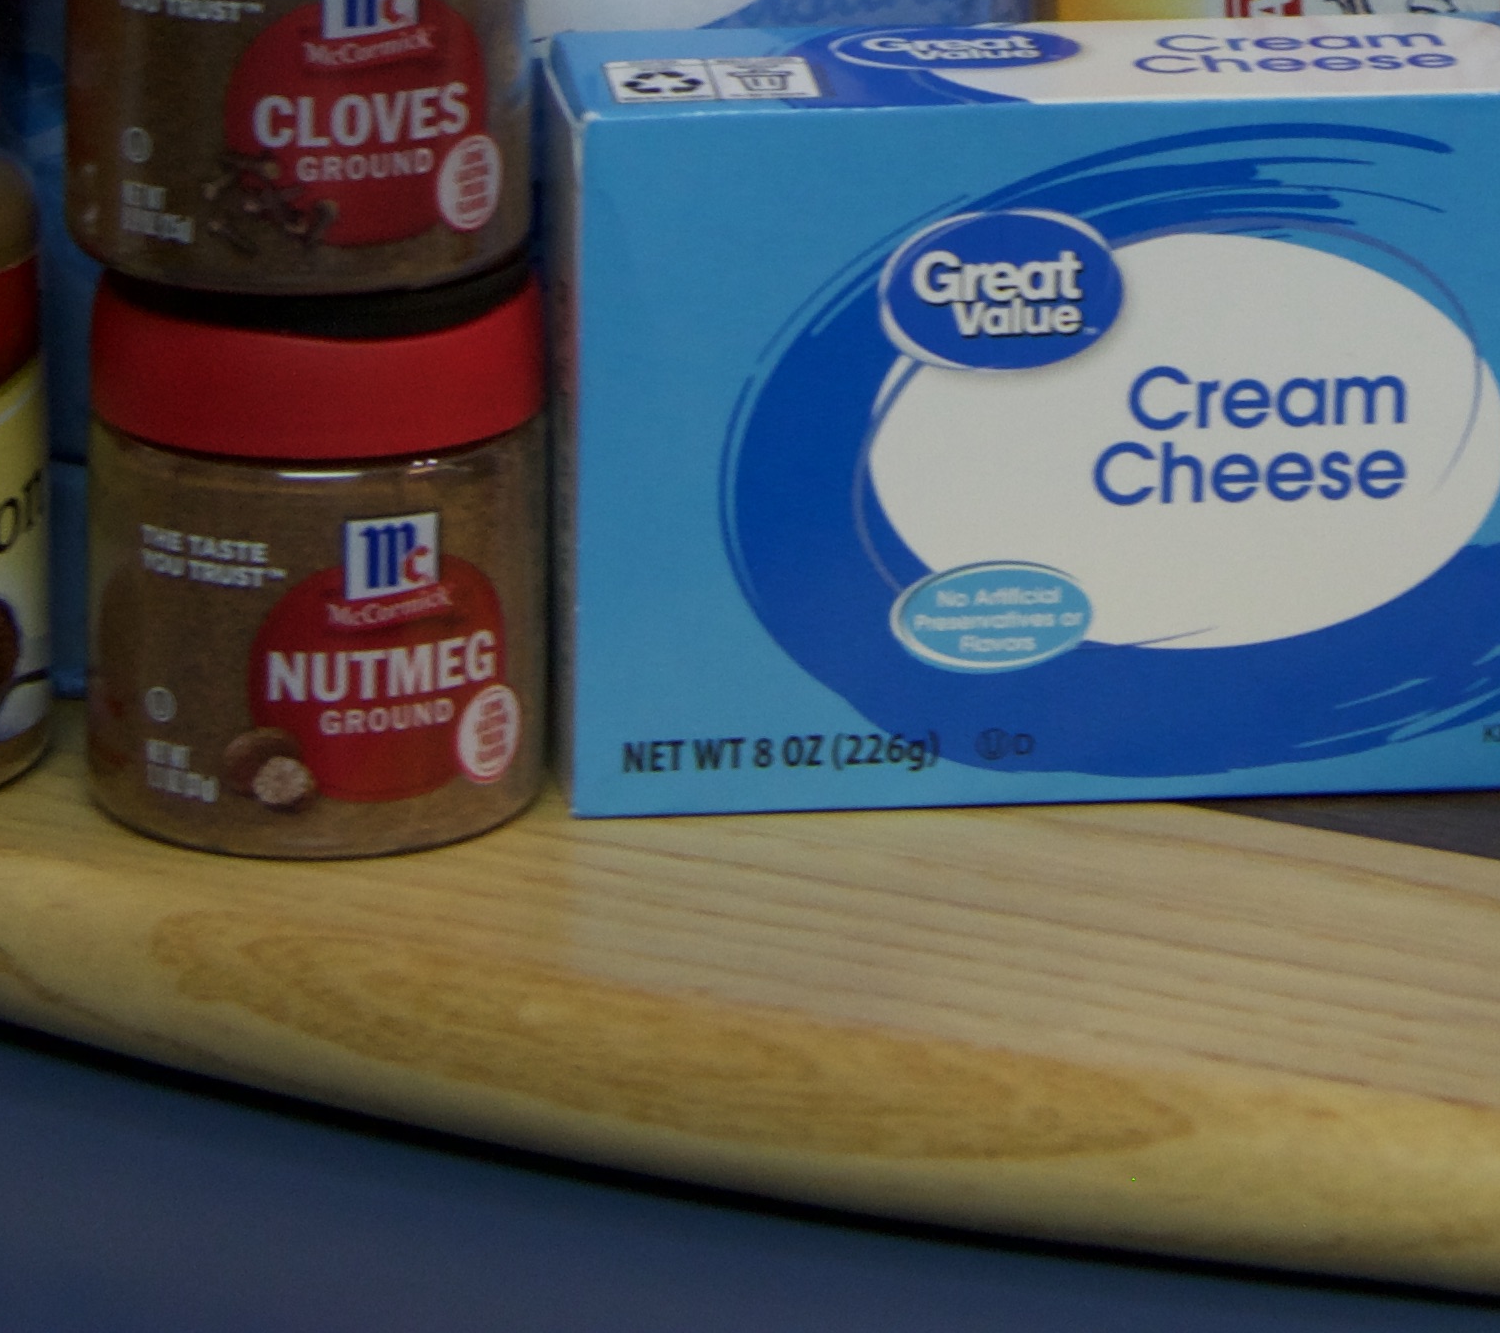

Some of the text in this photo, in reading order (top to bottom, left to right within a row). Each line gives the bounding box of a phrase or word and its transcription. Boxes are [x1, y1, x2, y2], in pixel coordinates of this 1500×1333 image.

[860, 35, 1041, 55] Great
[1132, 53, 1459, 75] Cheese
[1154, 32, 1447, 54] Cream
[252, 81, 471, 150] CLOVES
[295, 146, 434, 183] GROUND
[912, 247, 1085, 307] Great
[954, 294, 1083, 338] Value
[1128, 365, 1407, 432] Cream
[1093, 439, 1407, 507] Cheese
[187, 532, 269, 564] TASTE
[266, 629, 497, 703] NUTMEG
[318, 697, 456, 736] GROUND
[621, 728, 941, 774] NET WT 8 OZ (226g)
